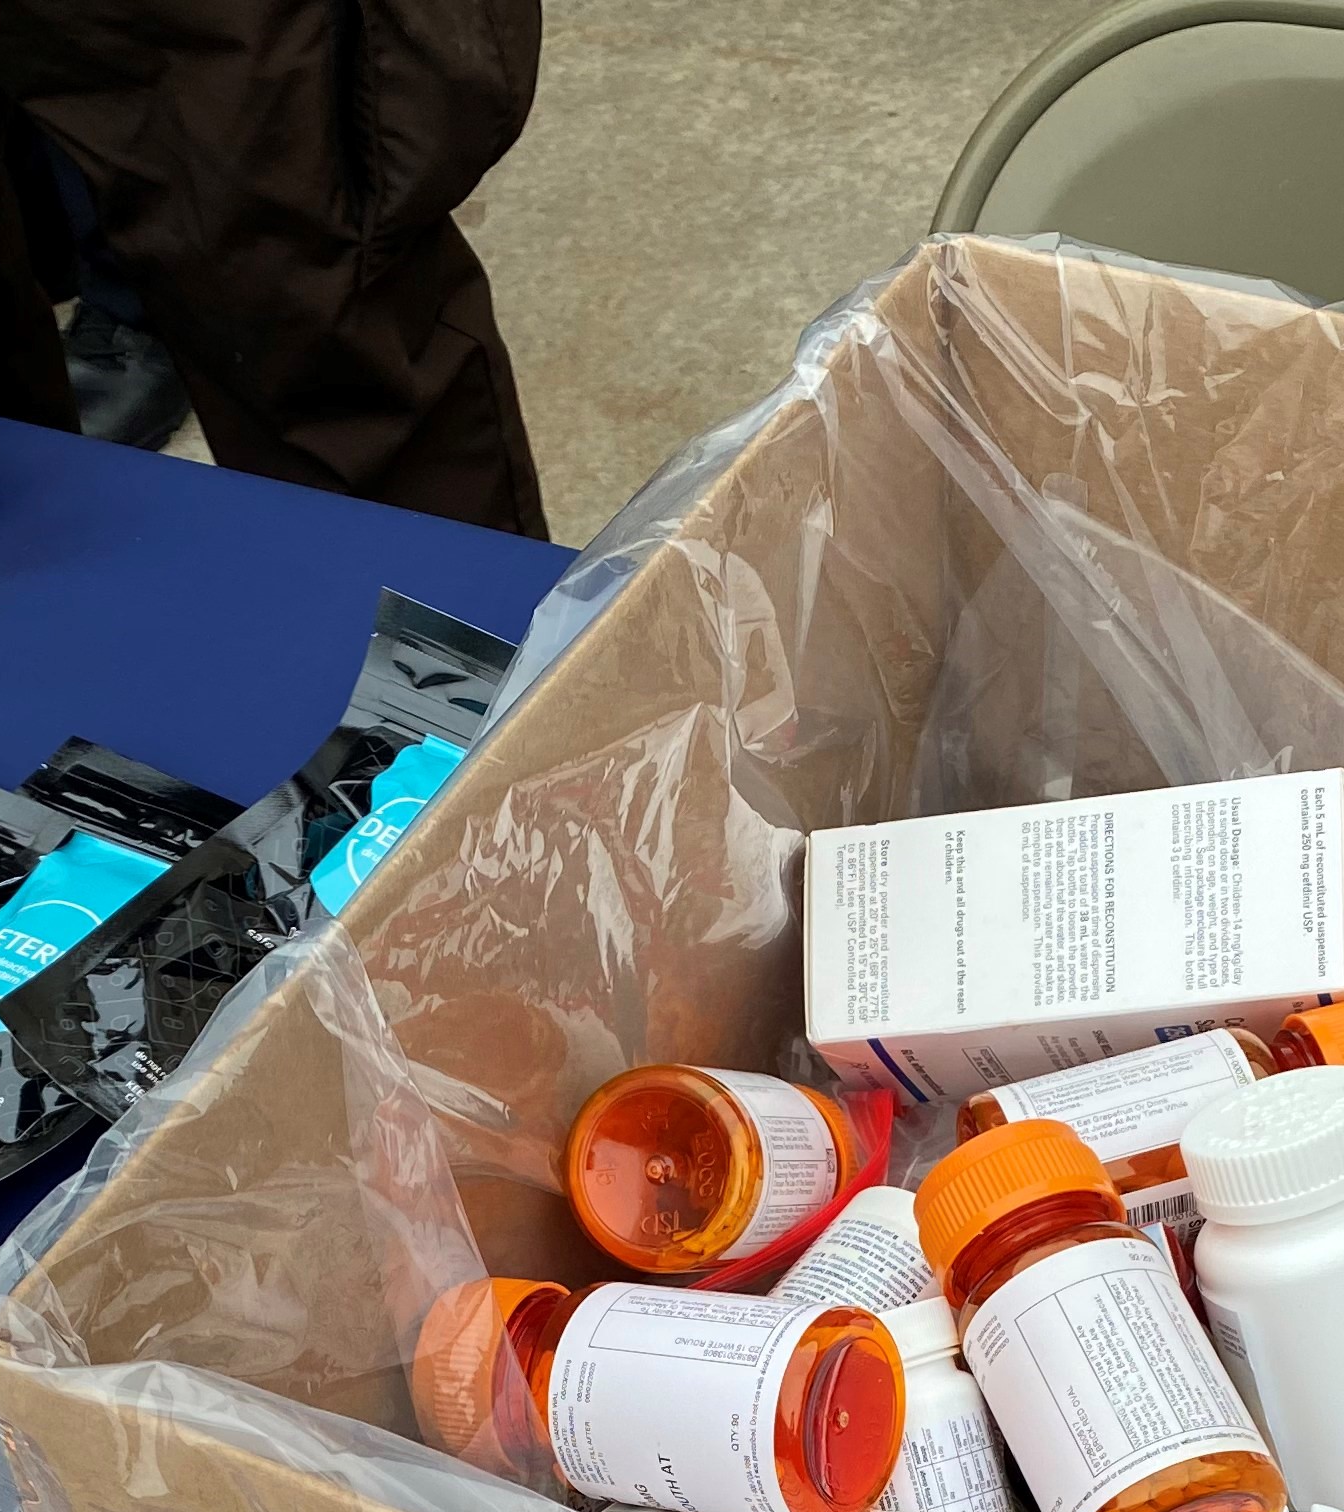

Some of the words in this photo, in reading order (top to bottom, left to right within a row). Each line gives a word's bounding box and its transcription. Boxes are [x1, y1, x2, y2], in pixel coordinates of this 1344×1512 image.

[1230, 796, 1241, 825] Usual
[1300, 788, 1309, 830] contains
[1314, 786, 1324, 811] Each
[944, 831, 953, 841] of
[954, 829, 965, 854] Keep
[1301, 832, 1311, 851] 250
[1315, 821, 1324, 837] mL
[880, 839, 889, 866] Store
[1103, 811, 1114, 874] DIRECTIONS
[1229, 828, 1241, 866] Dosage:
[1315, 839, 1325, 850] of
[944, 843, 954, 883] children.
[955, 856, 965, 873] this
[1299, 853, 1309, 869] mg
[878, 870, 888, 887] dry
[955, 876, 965, 894] and
[1104, 877, 1114, 898] FOR
[1301, 871, 1312, 908] cefdinir
[1315, 852, 1326, 918] reconstituted
[878, 890, 888, 928] powder
[956, 896, 965, 908] all
[954, 909, 965, 937] drugs
[879, 933, 889, 951] and
[956, 939, 964, 956] out
[1104, 900, 1115, 992] RECONSTITUTION
[1315, 921, 1326, 977] suspension
[956, 957, 965, 967] of
[1230, 933, 1243, 985] mg/kg/day
[880, 955, 890, 1021] reconstituted
[956, 969, 965, 985] the
[956, 988, 965, 1014] reach
[657, 1452, 676, 1476] AT
